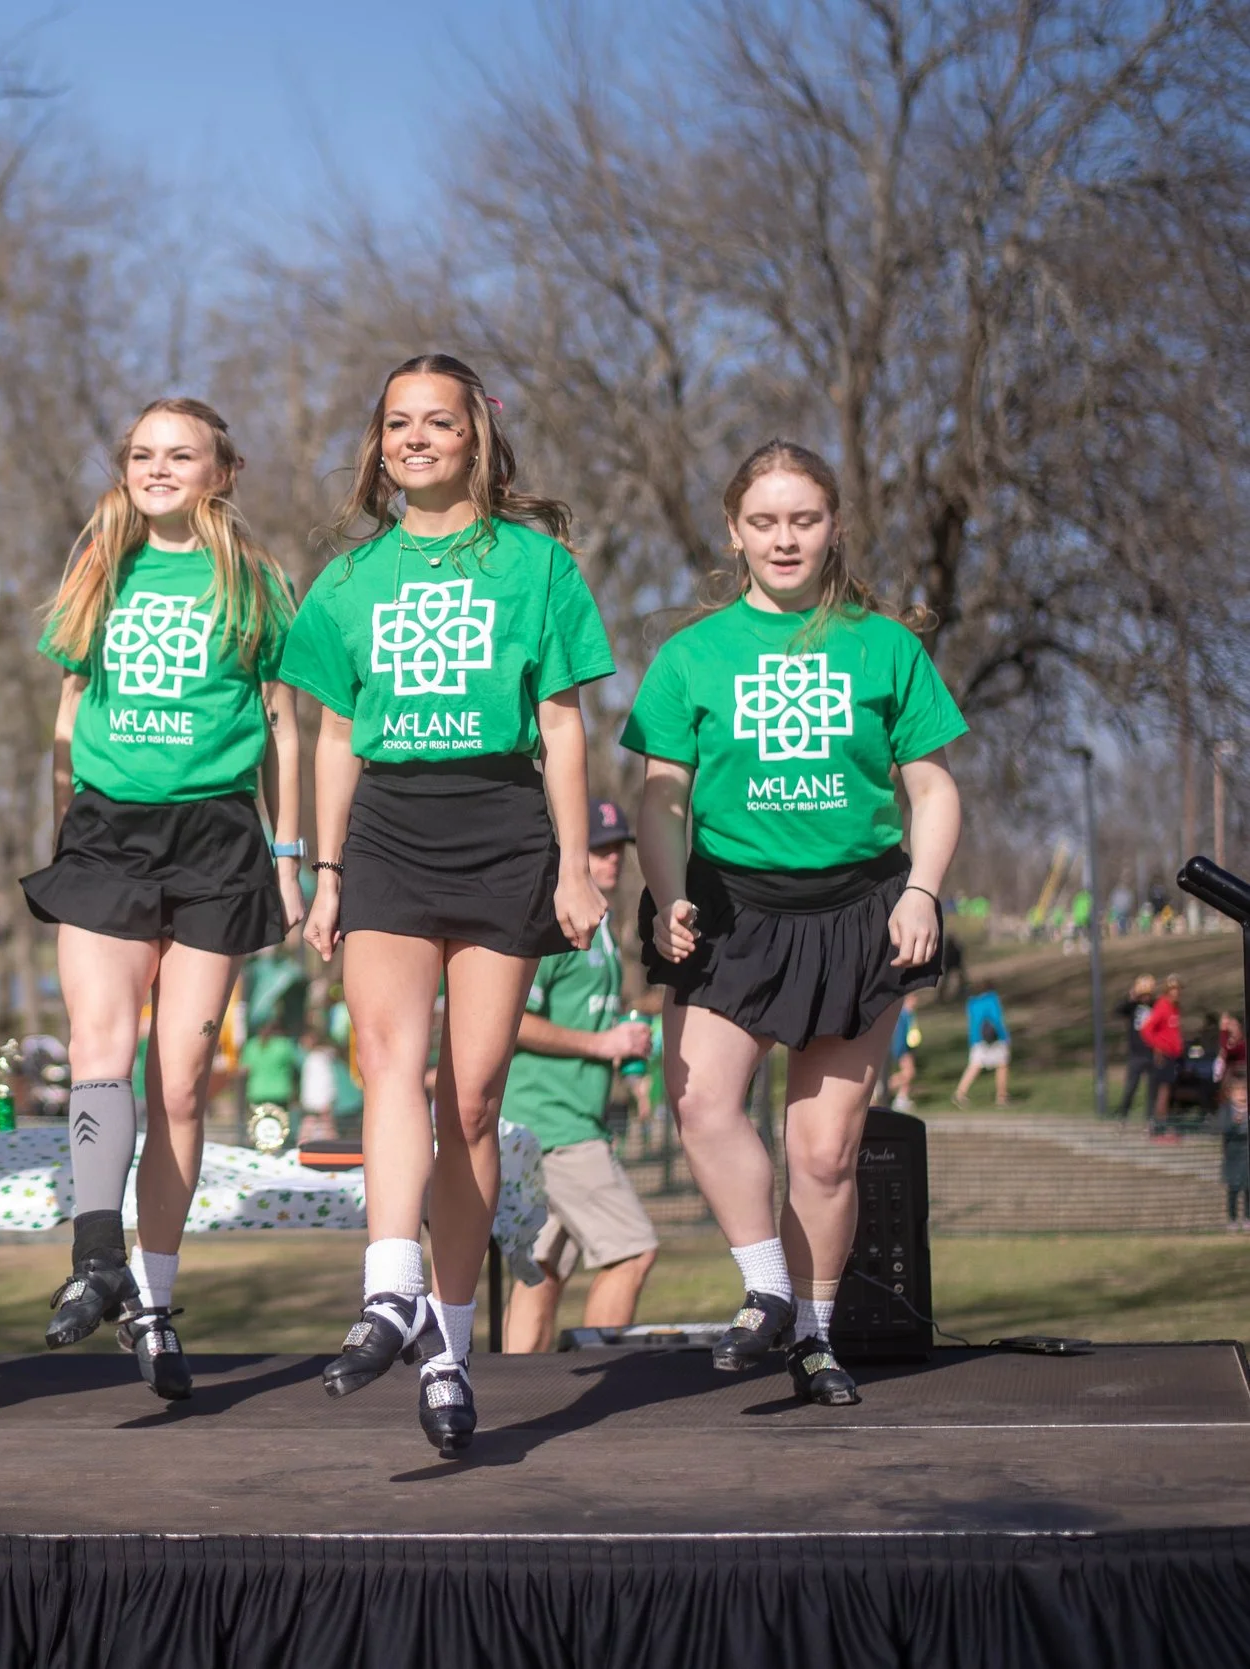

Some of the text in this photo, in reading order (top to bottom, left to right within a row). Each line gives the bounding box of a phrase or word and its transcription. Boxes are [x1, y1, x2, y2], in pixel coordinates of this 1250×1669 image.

[166, 735, 194, 745] DANCE
[382, 739, 482, 750] SCHOOL OF IRISH DANCE
[747, 798, 848, 811] SCHOOL OF IRISH DANCE
